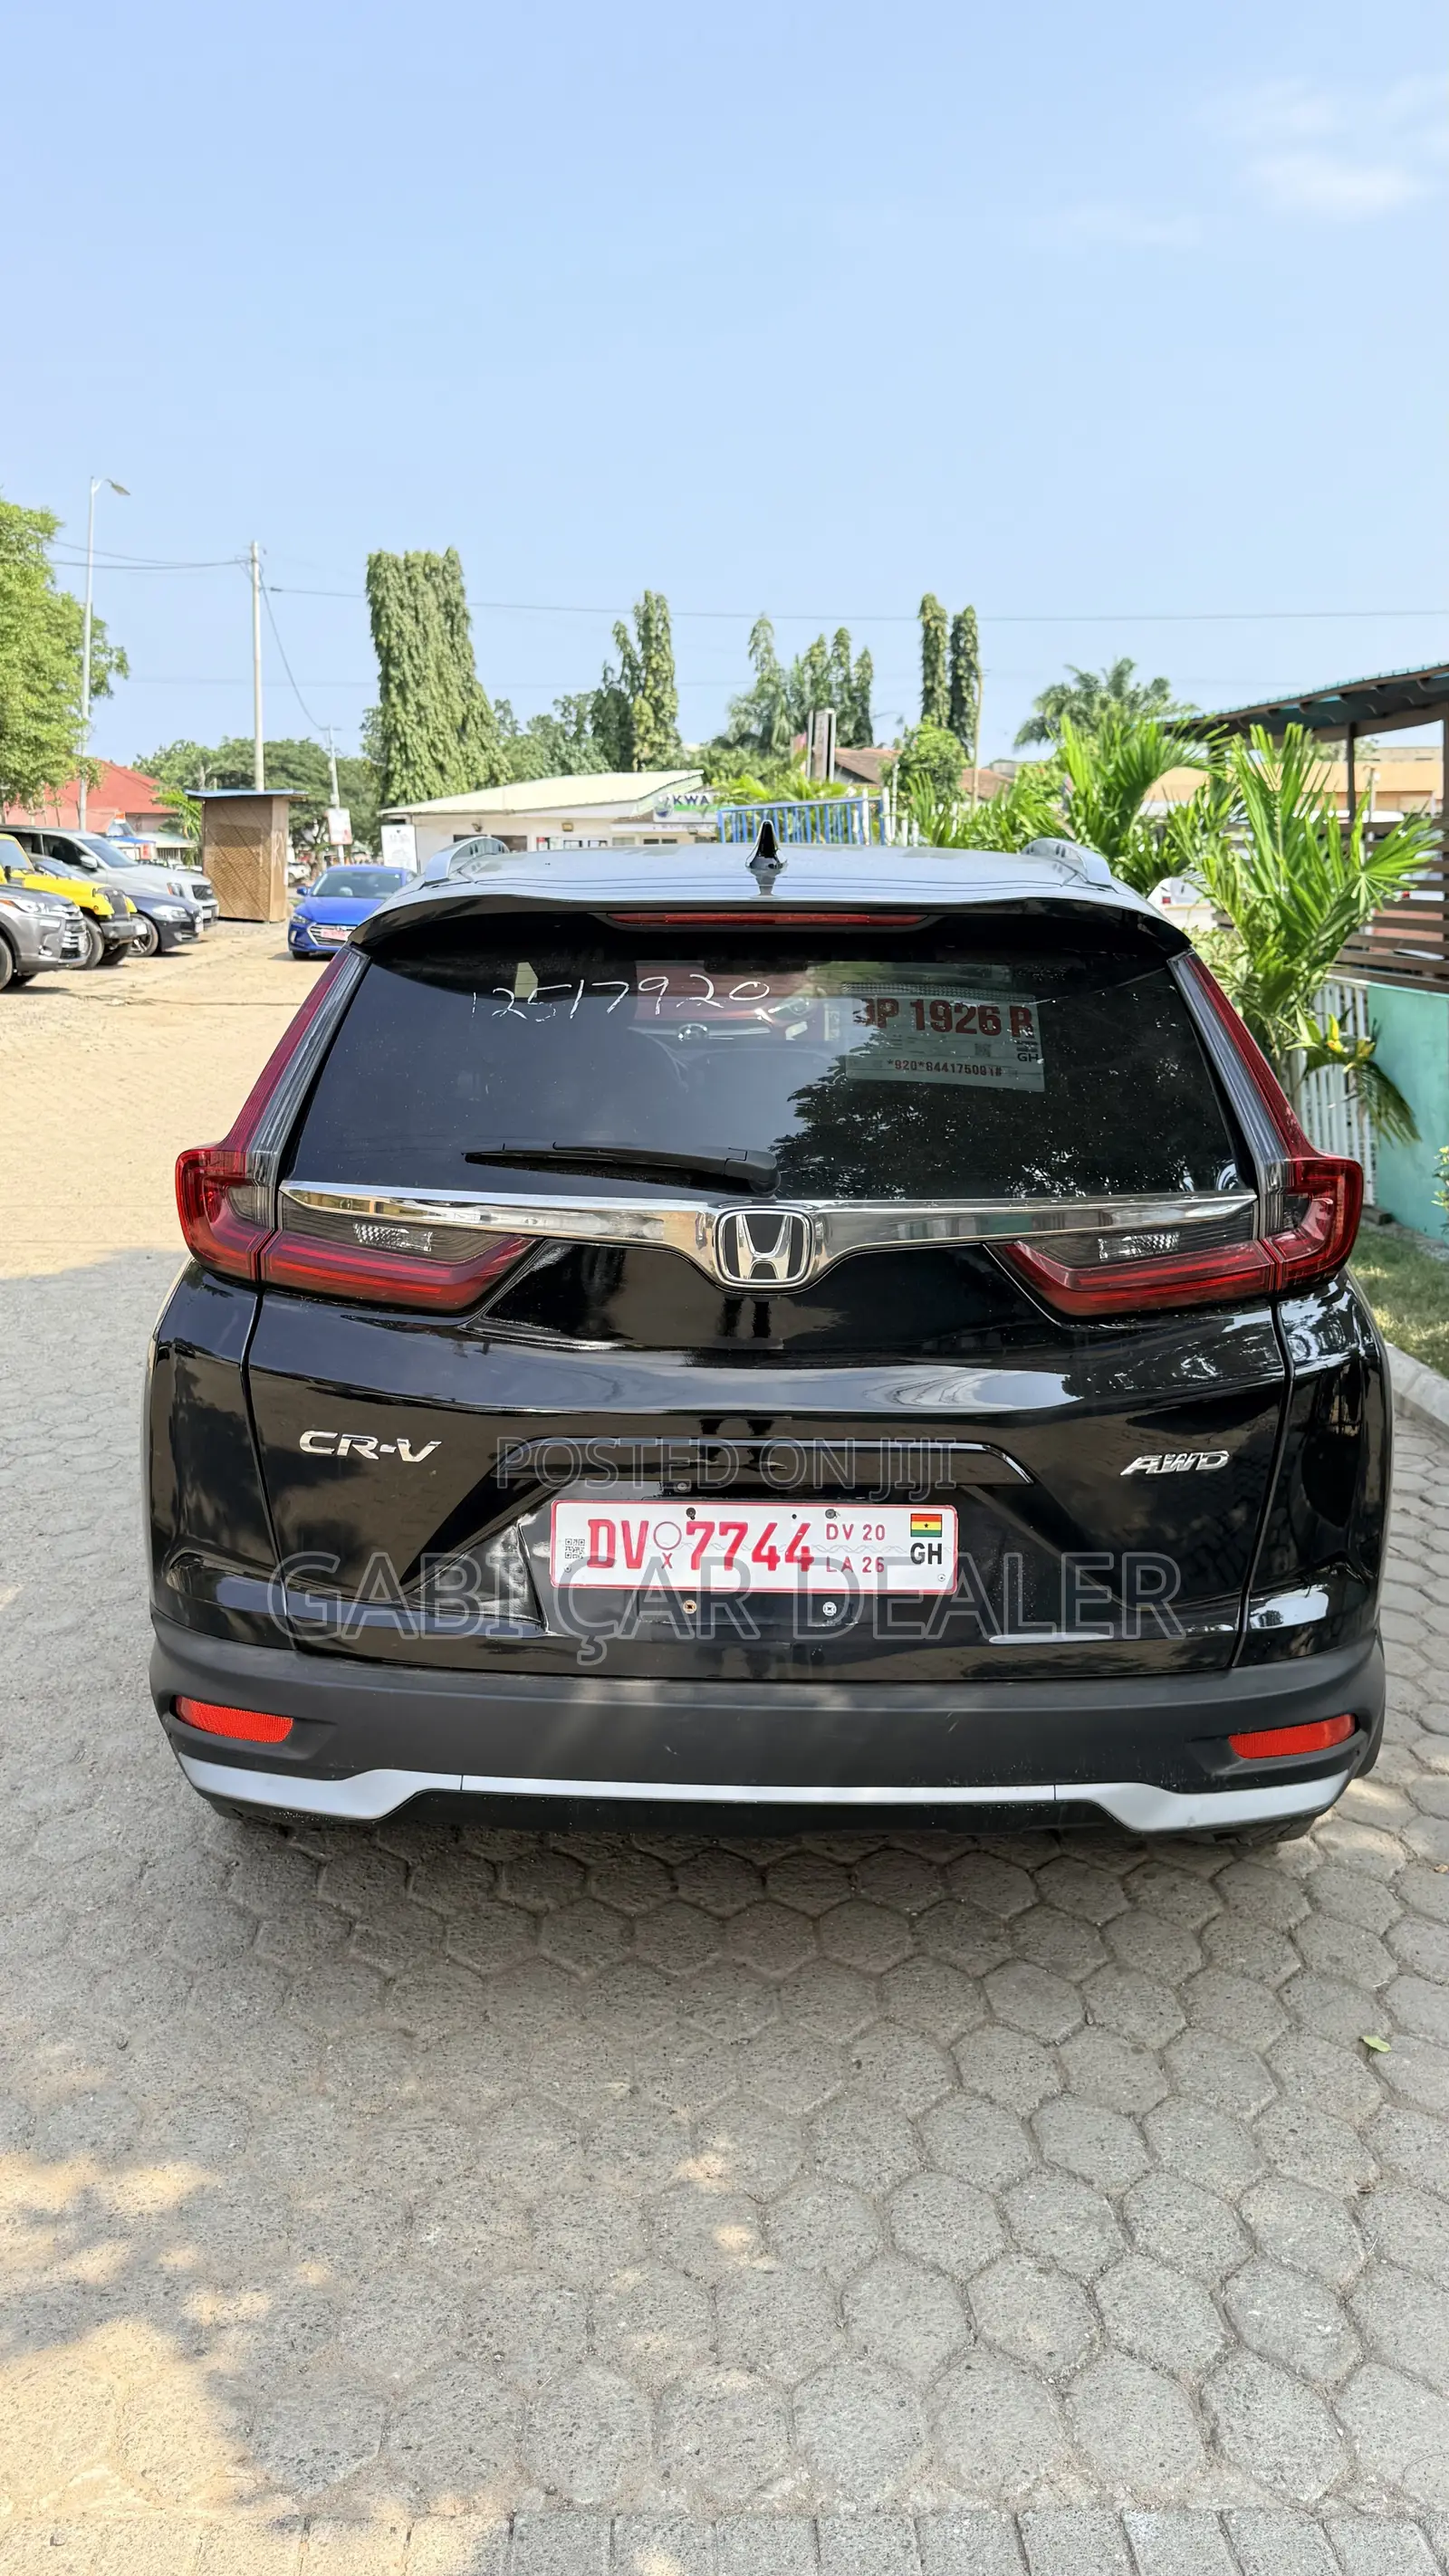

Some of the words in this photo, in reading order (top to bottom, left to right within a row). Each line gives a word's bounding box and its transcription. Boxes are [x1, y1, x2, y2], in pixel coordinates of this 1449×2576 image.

[909, 999, 1003, 1036] 1926
[1009, 1005, 1035, 1039] R
[1017, 1051, 1040, 1063] GH
[299, 1430, 442, 1462] CR-V
[1119, 1451, 1230, 1476] AWD
[826, 1523, 854, 1540] DV
[862, 1524, 886, 1541] 20
[587, 1518, 649, 1568] DV
[686, 1521, 815, 1572] 7744
[910, 1542, 943, 1565] GH
[826, 1556, 854, 1573] LA
[861, 1556, 885, 1573] 26
